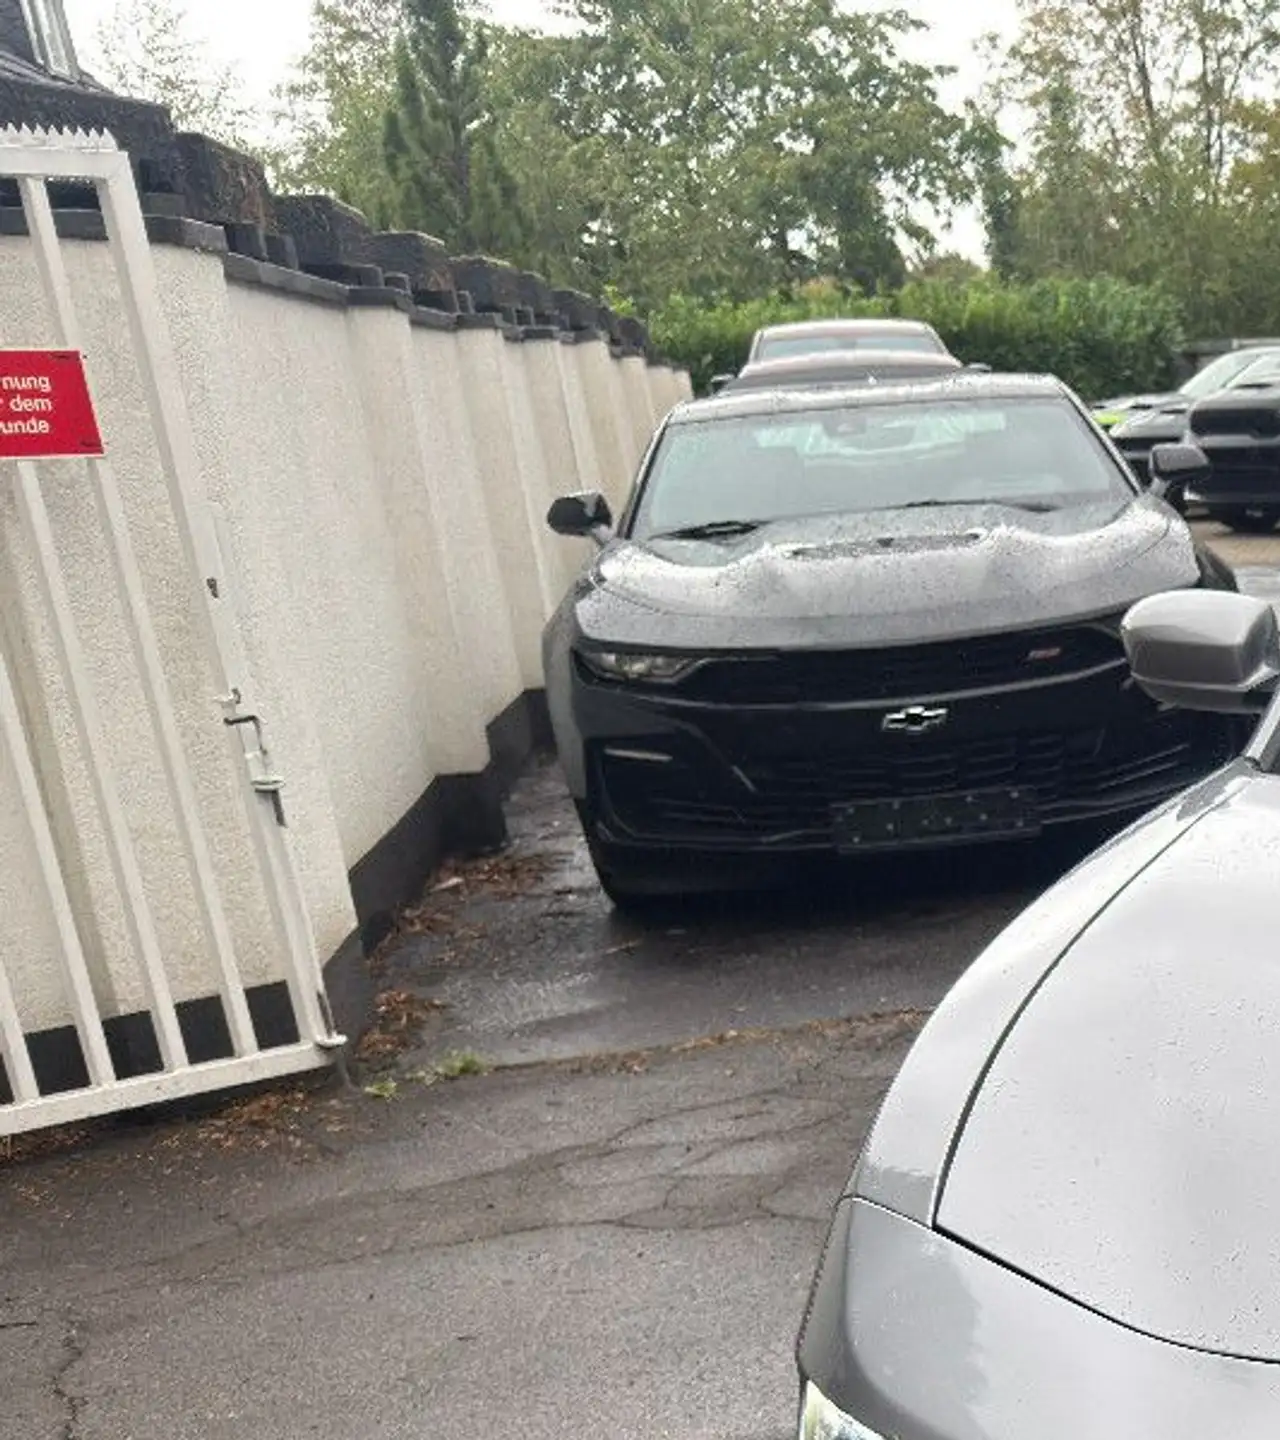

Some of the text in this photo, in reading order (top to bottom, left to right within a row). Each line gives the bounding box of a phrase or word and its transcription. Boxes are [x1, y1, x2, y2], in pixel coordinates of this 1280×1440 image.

[0, 376, 51, 393] nung
[9, 394, 52, 412] dem
[0, 417, 50, 434] unde
